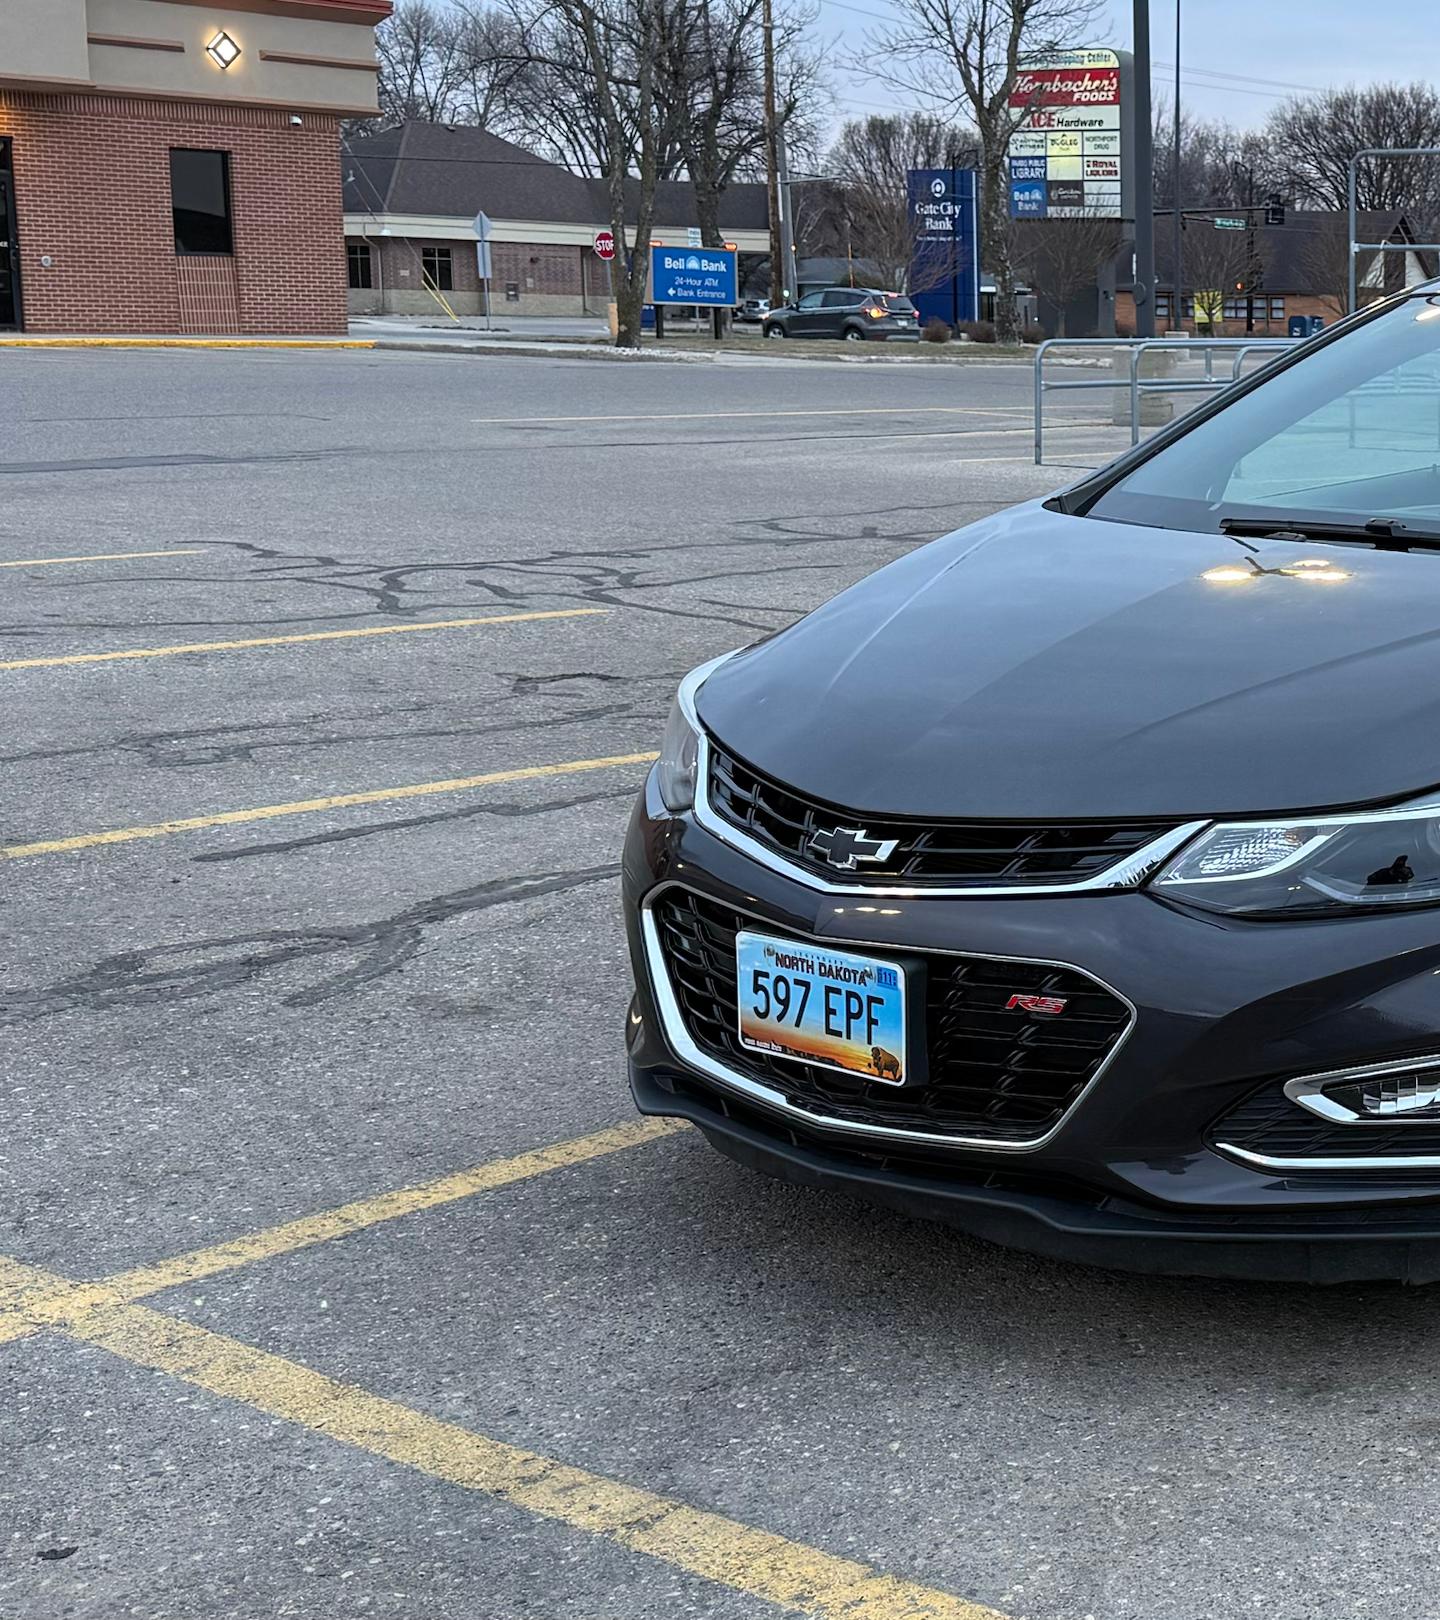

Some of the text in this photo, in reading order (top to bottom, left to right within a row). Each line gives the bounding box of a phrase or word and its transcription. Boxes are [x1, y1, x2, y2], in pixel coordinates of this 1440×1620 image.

[1011, 72, 1117, 93] Hornbacher's
[1073, 91, 1115, 102] FOODS
[1024, 110, 1104, 128] ACE Hardware
[1092, 160, 1117, 168] ROYAL
[1012, 168, 1045, 180] LIBRARY
[1013, 191, 1030, 201] Bell
[915, 201, 939, 215] Gate
[1018, 201, 1039, 211] Bank
[925, 217, 953, 230] Bank
[664, 257, 727, 273] Bell Bank
[674, 276, 719, 287] 24-Hour ATM
[677, 288, 726, 299] Bank Entrance
[774, 952, 867, 987] NORTH DAKOTA
[753, 969, 884, 1045] 597 EPF
[1005, 994, 1067, 1013] RS
